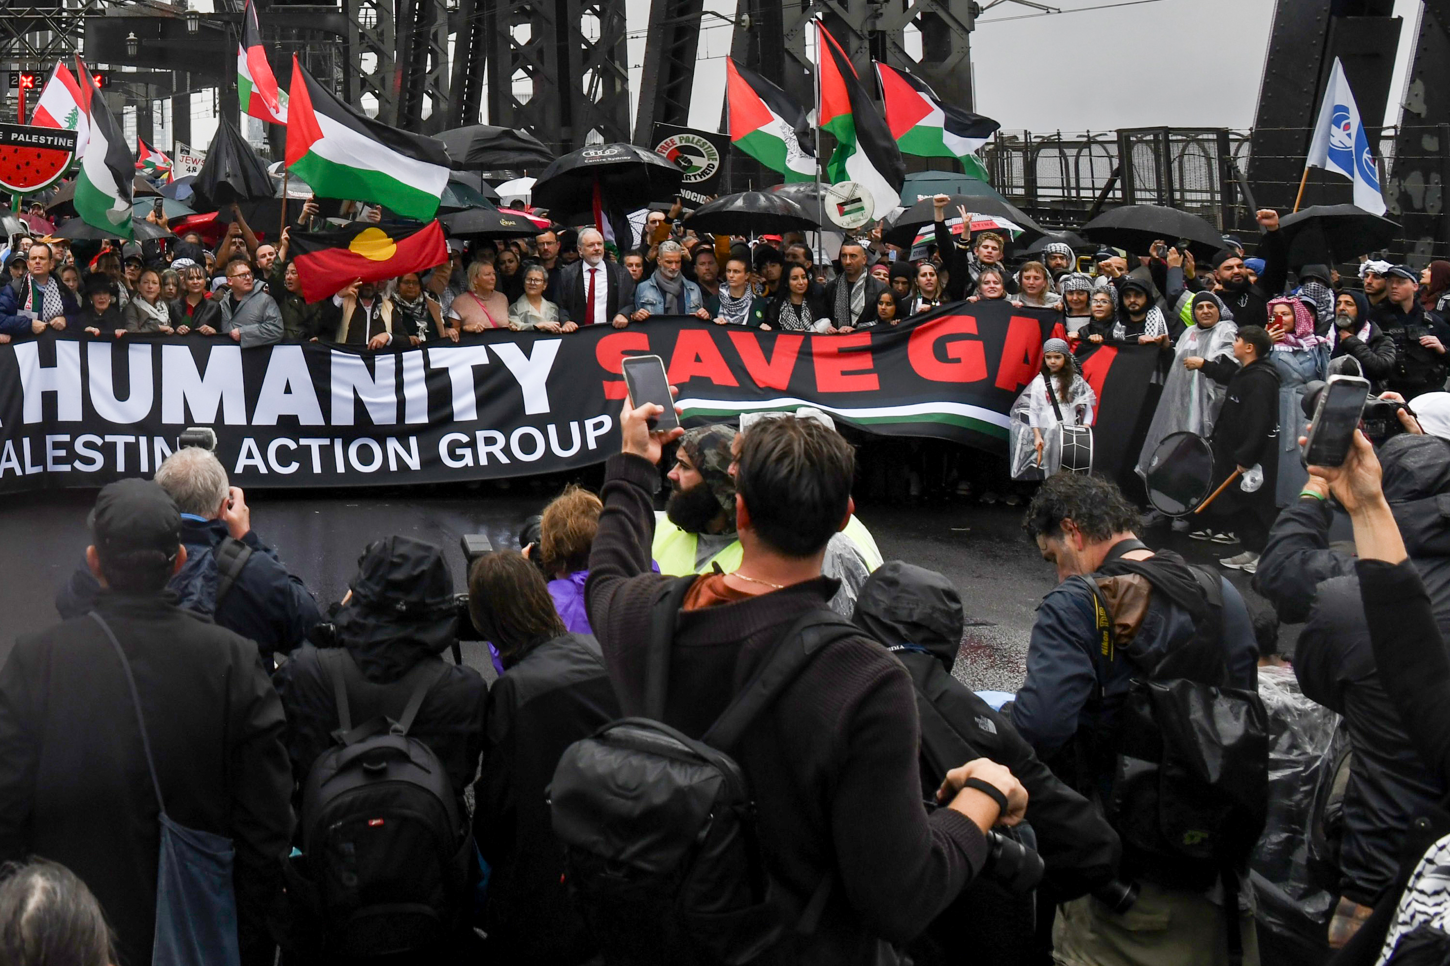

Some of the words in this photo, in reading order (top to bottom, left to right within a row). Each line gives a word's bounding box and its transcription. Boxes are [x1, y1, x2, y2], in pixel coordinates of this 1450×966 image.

[11, 76, 18, 84] 2
[35, 76, 42, 84] 2
[11, 132, 74, 147] PALESTINE
[656, 137, 677, 155] FREE
[678, 135, 718, 162] PALESTINE
[595, 328, 880, 400] SAVE
[13, 337, 562, 427] HUMANITY
[235, 436, 422, 475] ACTION
[439, 414, 613, 469] GROUP
[1101, 630, 1109, 656] Nikon
